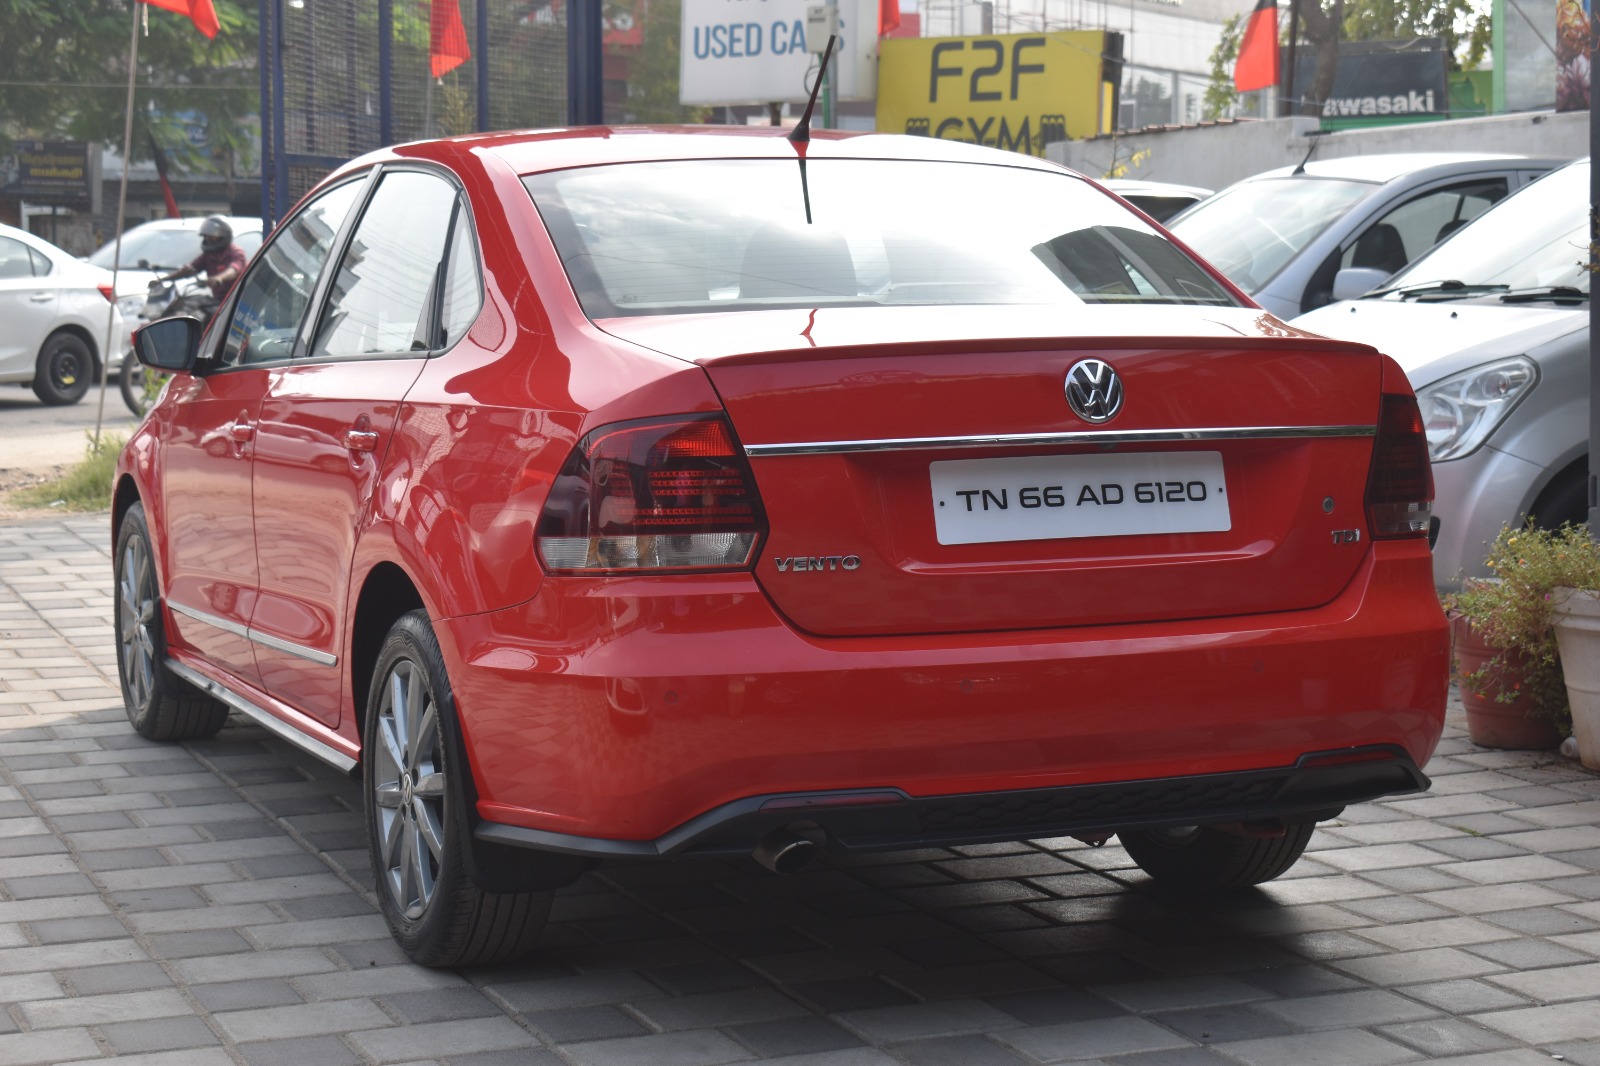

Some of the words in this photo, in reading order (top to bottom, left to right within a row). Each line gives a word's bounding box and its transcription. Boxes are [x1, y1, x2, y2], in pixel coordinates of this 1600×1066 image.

[694, 23, 762, 59] USED
[770, 20, 845, 55] CA
[929, 37, 1046, 103] F2F
[1301, 89, 1435, 117] awasaki
[956, 488, 1008, 511] TN
[1019, 486, 1065, 509] 66
[1076, 483, 1124, 506] AD
[1134, 480, 1207, 503] 6120
[774, 554, 861, 572] VENTO
